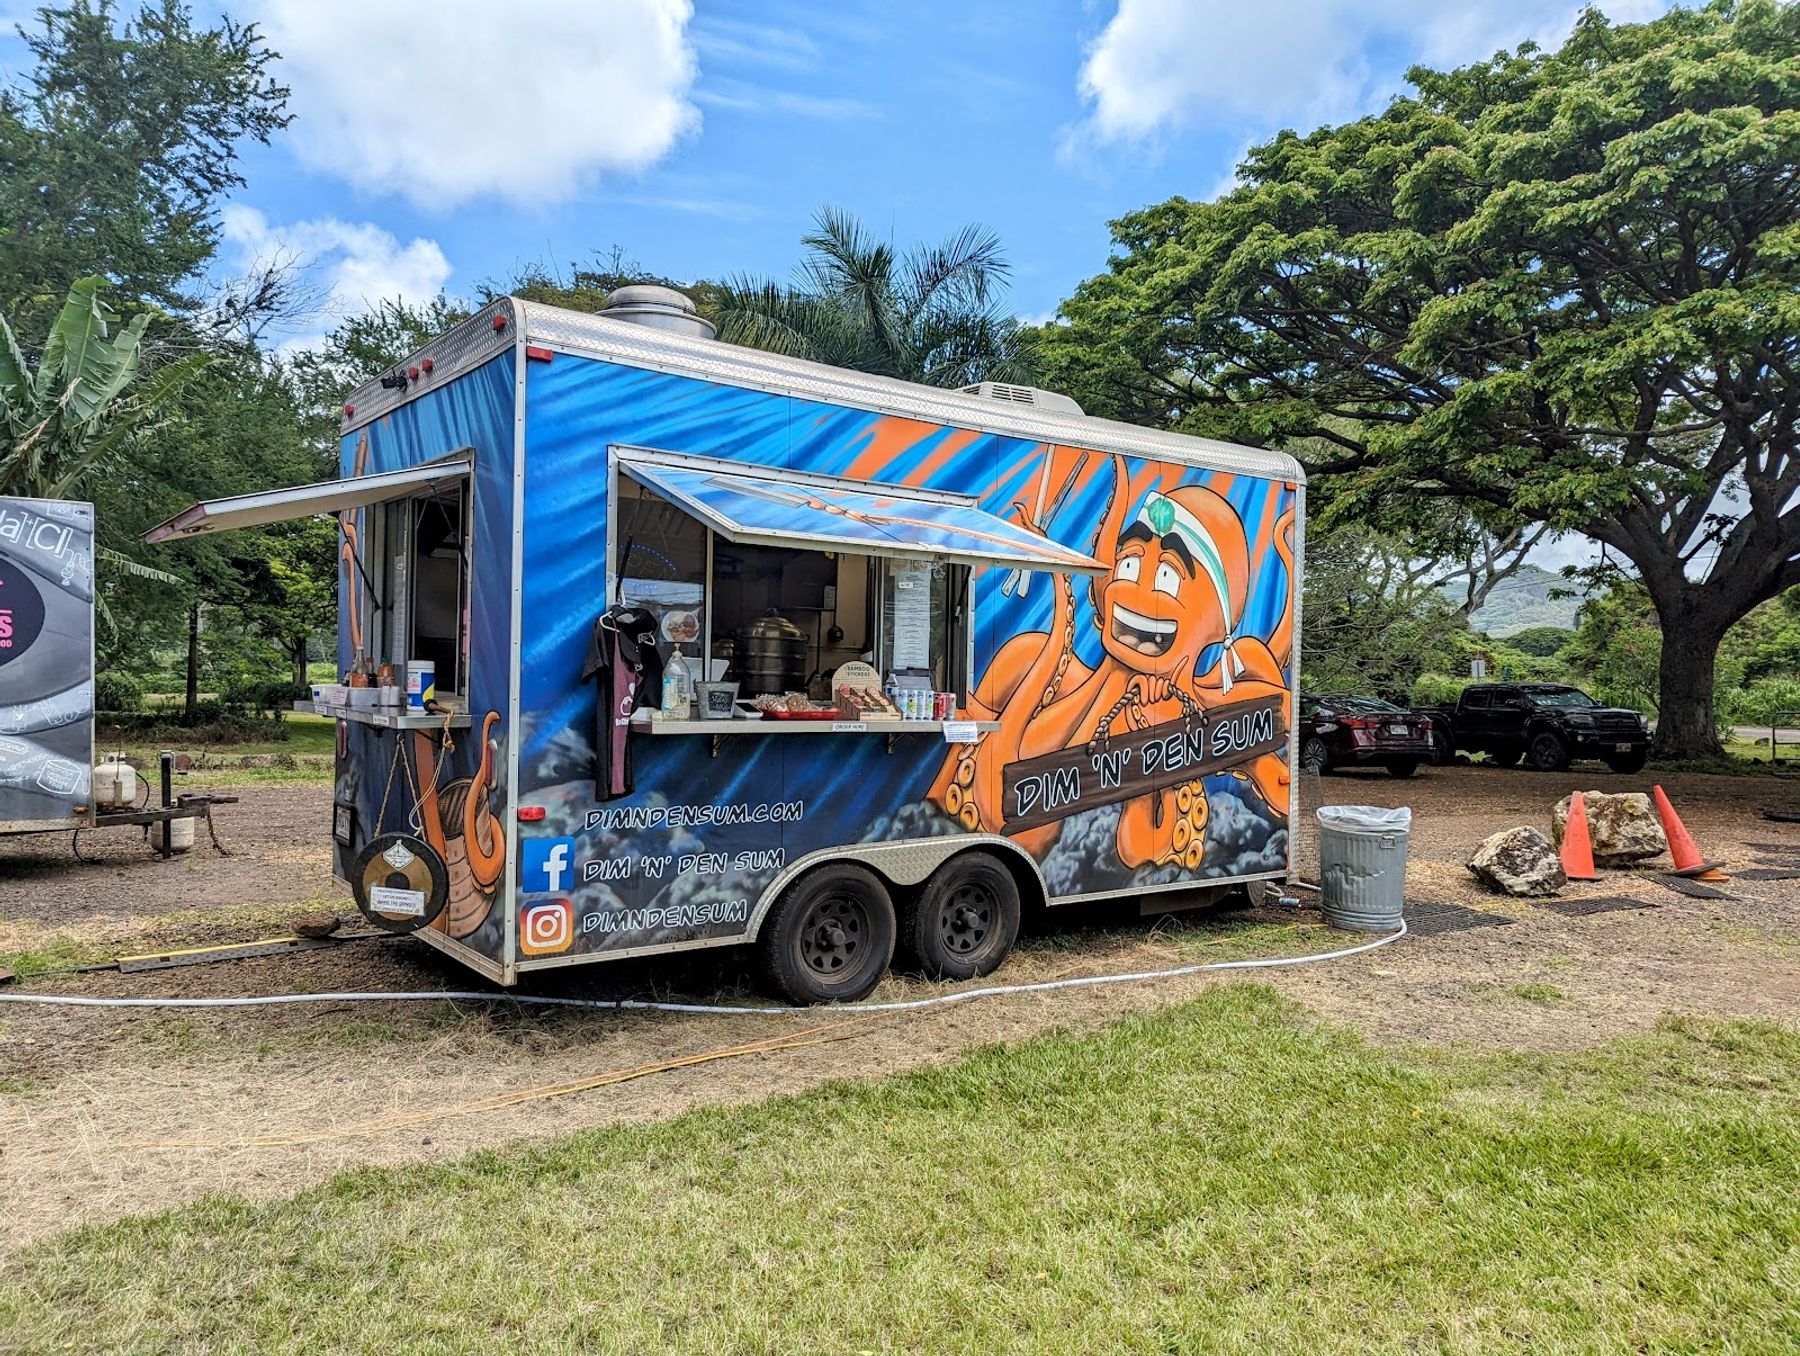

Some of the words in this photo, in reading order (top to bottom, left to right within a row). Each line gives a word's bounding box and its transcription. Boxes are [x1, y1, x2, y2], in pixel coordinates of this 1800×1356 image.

[1014, 766, 1081, 816] DIM
[1141, 727, 1204, 775] DEN
[1210, 708, 1274, 756] SUM
[584, 800, 804, 830] DIMNDENSUM.COM
[583, 856, 632, 882] DIM
[677, 852, 728, 874] DEN
[734, 848, 786, 871] SUM
[582, 899, 748, 933] DIMNDENSUM
